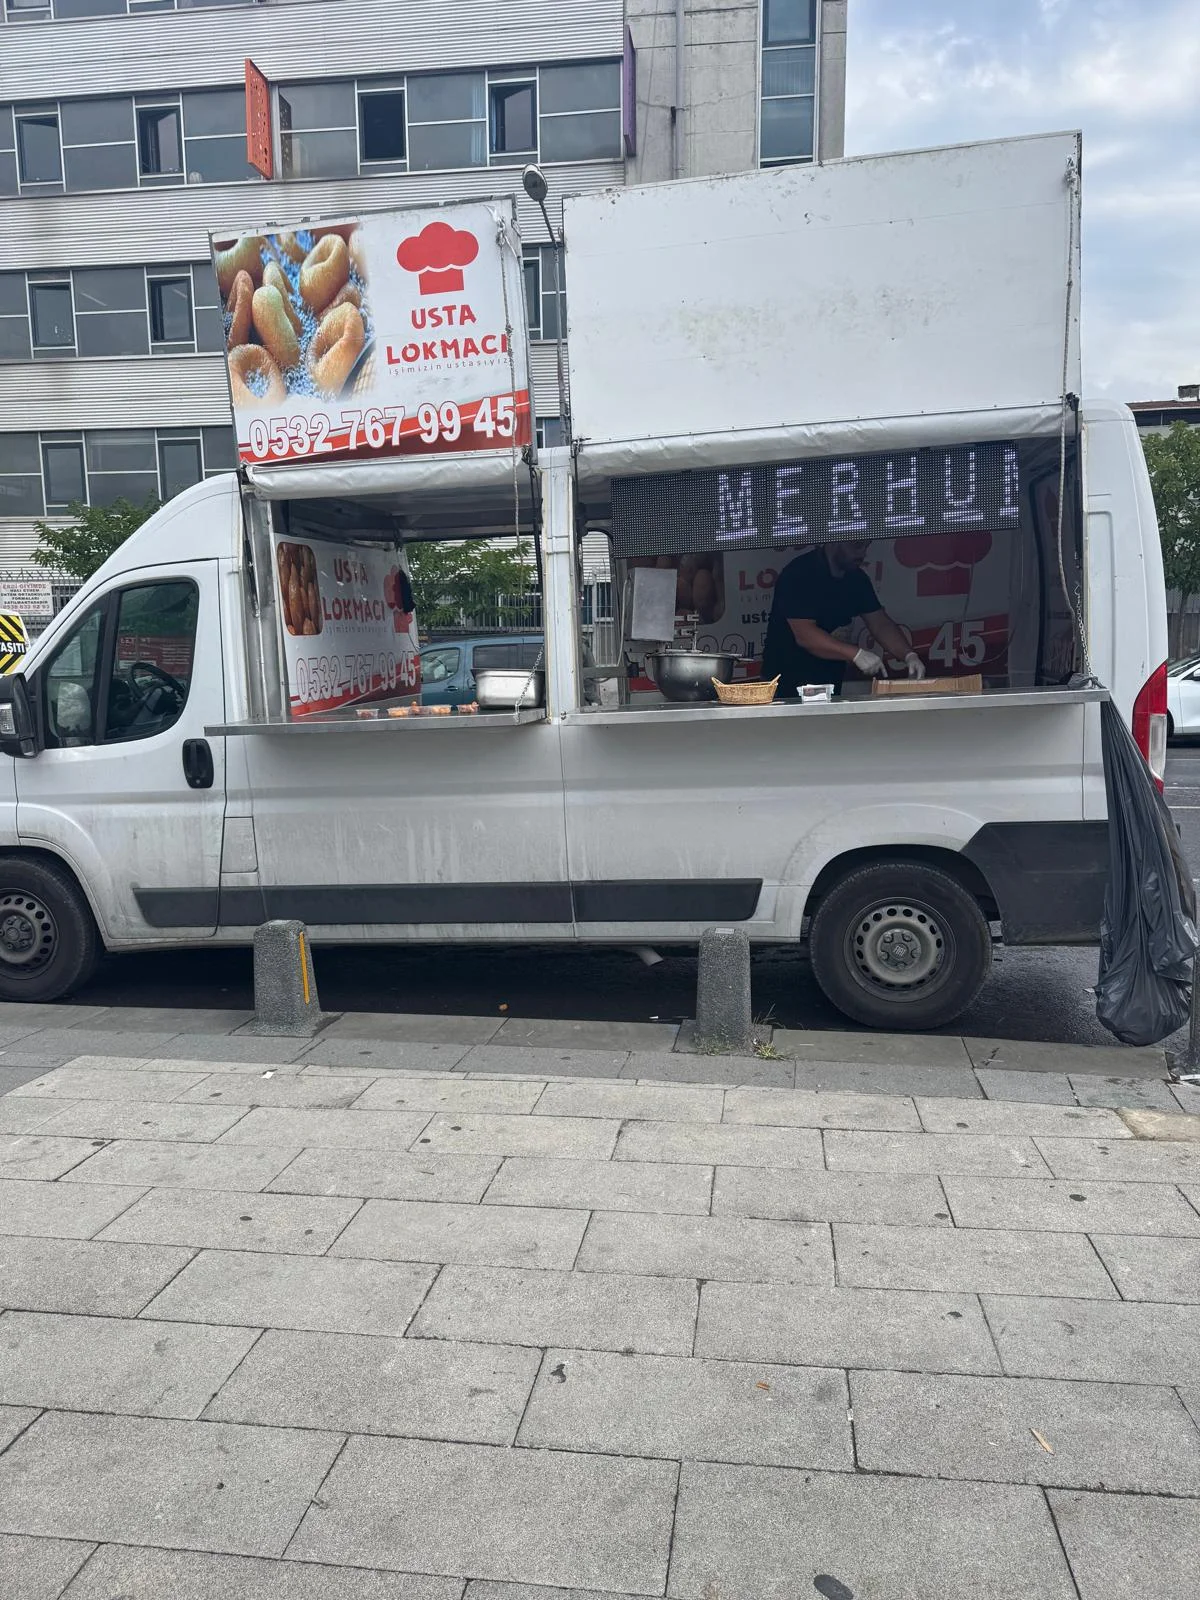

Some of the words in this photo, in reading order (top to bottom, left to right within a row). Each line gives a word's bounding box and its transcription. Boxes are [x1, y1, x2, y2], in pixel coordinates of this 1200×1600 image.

[411, 304, 477, 330] USTA
[386, 333, 508, 365] LOKMACI
[389, 362, 442, 376] işimizin
[249, 413, 332, 459] 0532
[341, 406, 405, 449] 767
[417, 401, 461, 445] 99
[473, 396, 516, 439] 45
[334, 558, 368, 585] USTA
[322, 596, 386, 622] LOKMACI
[929, 620, 986, 668] 45
[295, 657, 343, 704] 0532
[345, 653, 375, 695] 767
[380, 650, 397, 691] 99
[400, 650, 416, 687] 45
